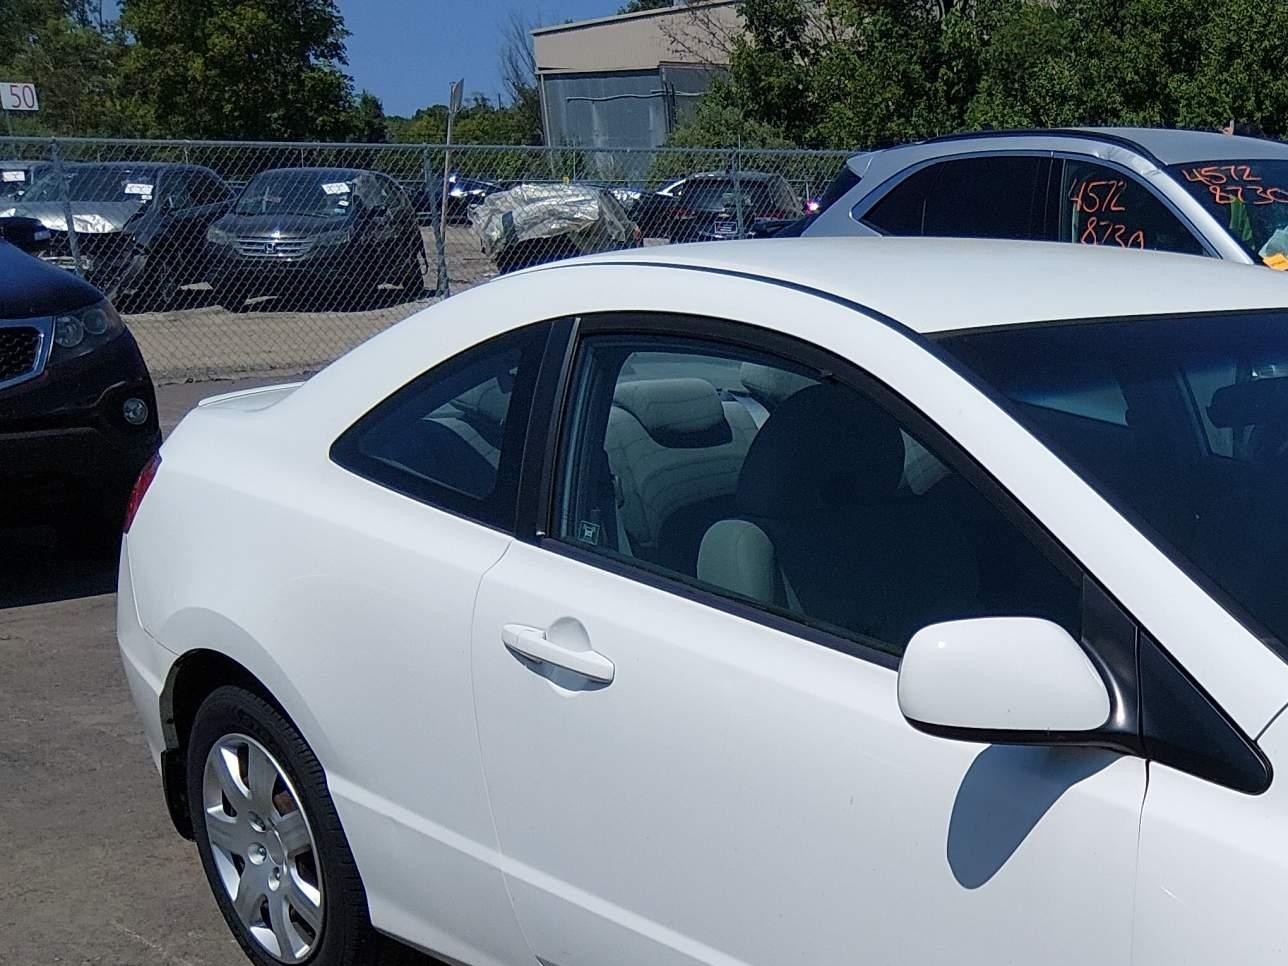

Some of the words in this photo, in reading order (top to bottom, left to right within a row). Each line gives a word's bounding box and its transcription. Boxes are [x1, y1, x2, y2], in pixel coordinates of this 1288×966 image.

[10, 85, 35, 109] 50
[1182, 164, 1262, 187] 4572
[1069, 175, 1126, 212] 4572
